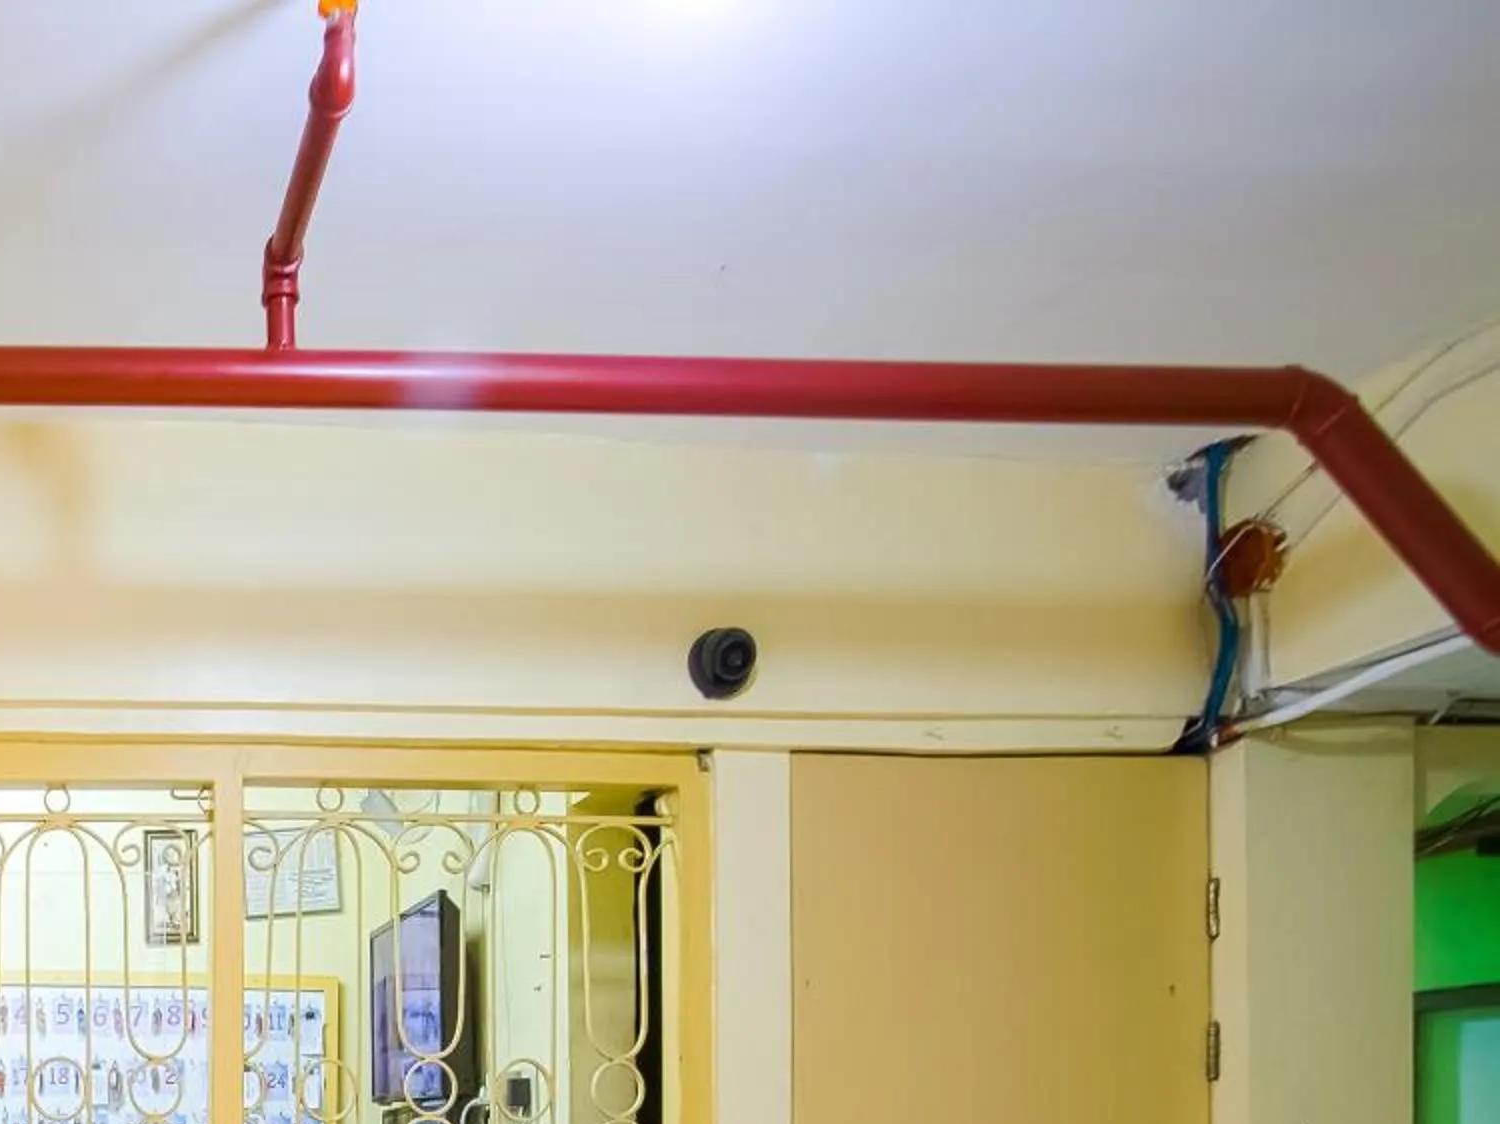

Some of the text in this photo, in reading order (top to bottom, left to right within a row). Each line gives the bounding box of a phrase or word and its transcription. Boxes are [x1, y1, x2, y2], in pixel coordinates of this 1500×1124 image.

[56, 1003, 70, 1025] 5
[93, 1005, 107, 1027] 6
[130, 1005, 143, 1027] 7
[167, 1005, 181, 1026] 8
[49, 1066, 70, 1086] 18
[266, 1072, 287, 1090] 24
